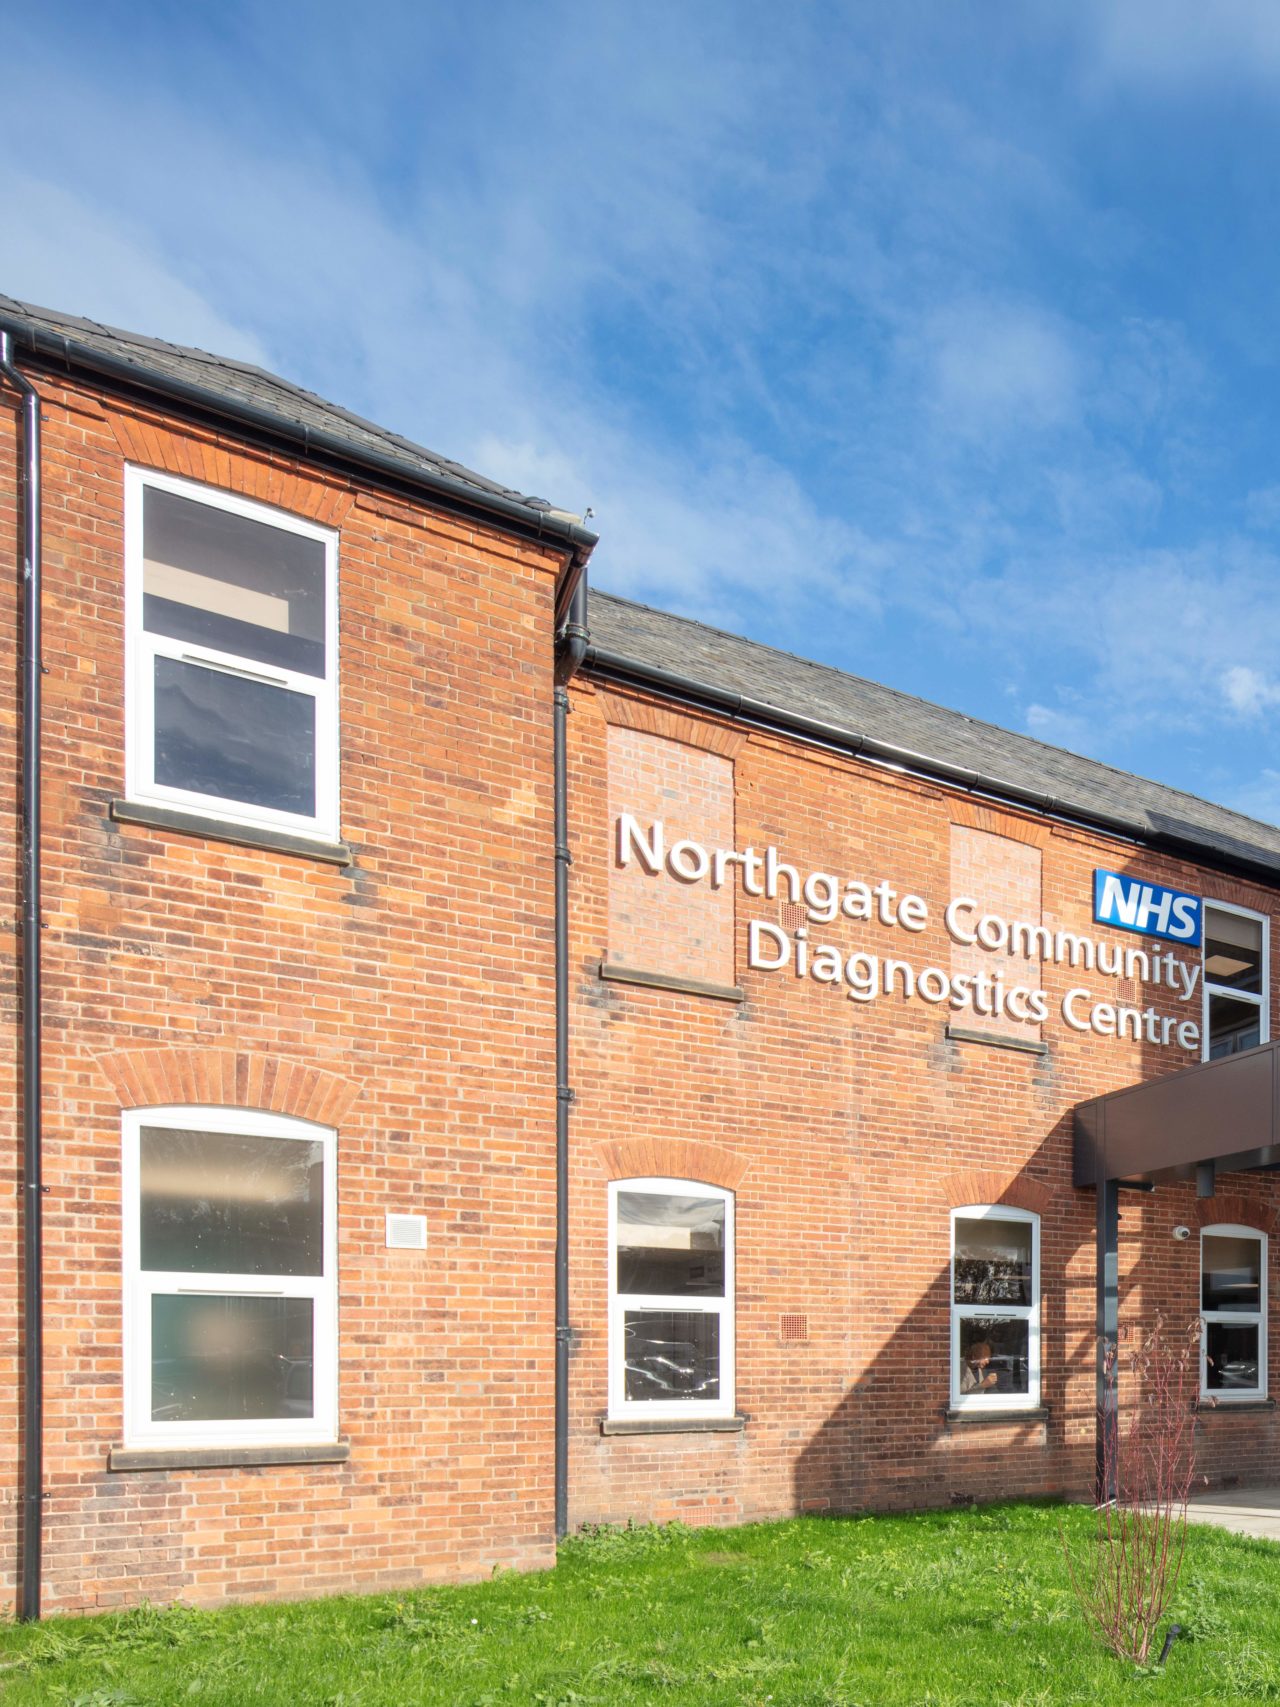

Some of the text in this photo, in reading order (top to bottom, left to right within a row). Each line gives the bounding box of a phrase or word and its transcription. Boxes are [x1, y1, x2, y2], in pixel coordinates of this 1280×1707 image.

[618, 812, 1201, 1001] Northgate Community
[1099, 875, 1198, 939] NHS
[748, 919, 1200, 1050] Diagnostics Centre
